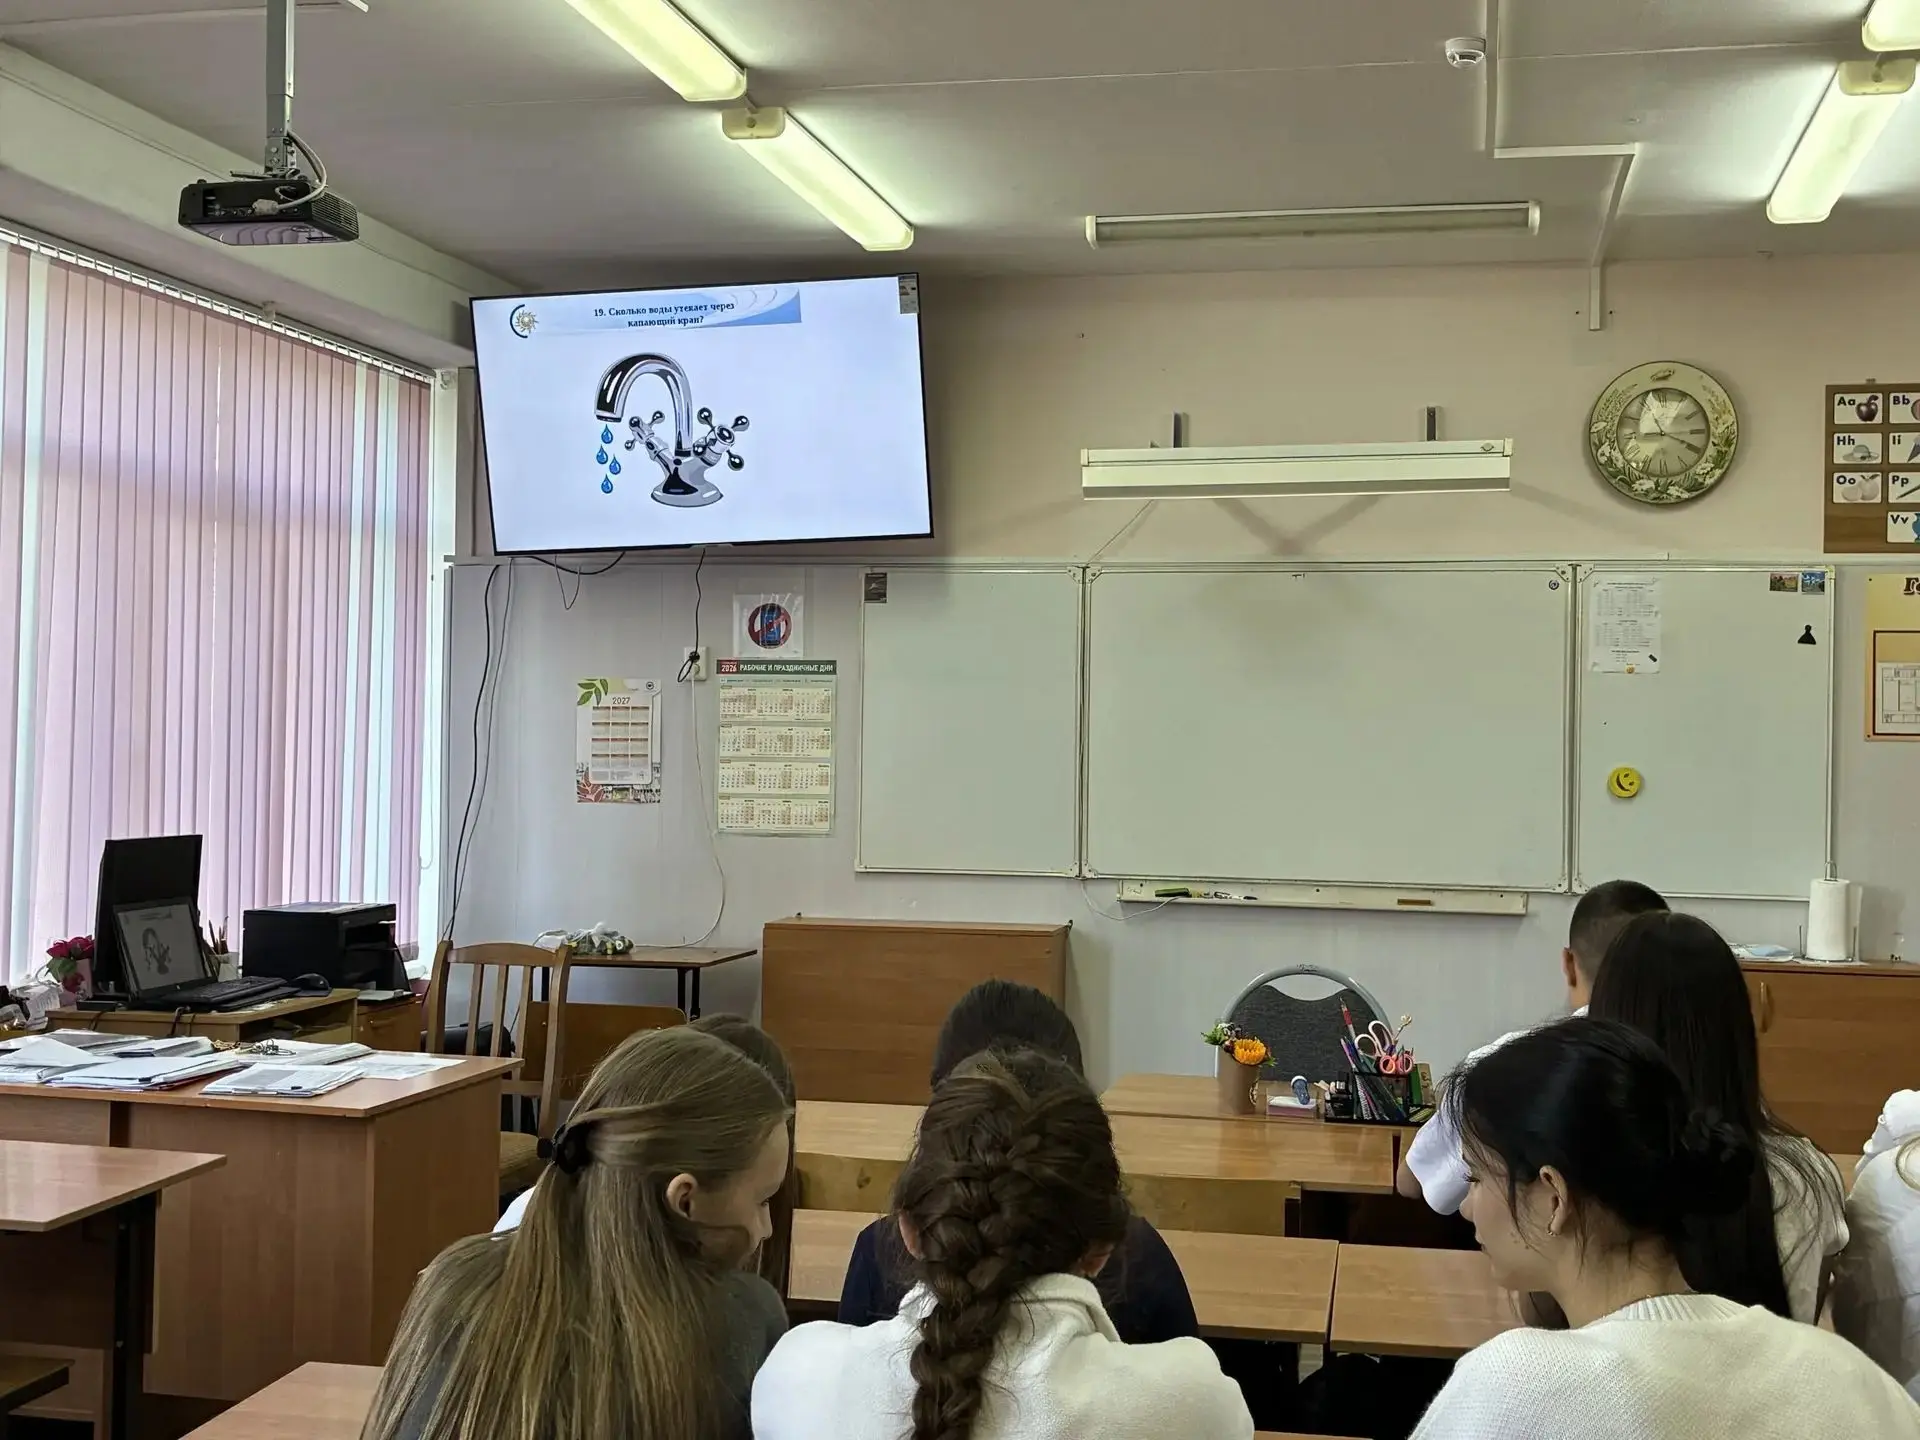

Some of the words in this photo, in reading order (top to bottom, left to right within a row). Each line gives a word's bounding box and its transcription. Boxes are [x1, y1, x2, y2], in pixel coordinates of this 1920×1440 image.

[594, 308, 606, 317] 19.
[608, 307, 647, 316] Сколько
[649, 306, 672, 315] воды
[674, 304, 708, 314] утекает
[711, 302, 735, 313] через
[628, 316, 675, 328] капающий
[678, 315, 704, 327] кран?
[1837, 396, 1856, 406] Aa
[1892, 395, 1911, 406] Bb
[1836, 436, 1856, 446] Hh
[1892, 435, 1901, 445] Ii
[1836, 475, 1856, 485] Oo
[1892, 475, 1909, 488] Pp
[1890, 514, 1909, 524] Vv
[721, 664, 737, 672] 2026
[740, 664, 767, 672] РАБОЧИЕ
[774, 664, 818, 672] ПРАЗДНИЧНЫЕ
[820, 664, 833, 673] ДНИ
[612, 697, 631, 705] 2027
